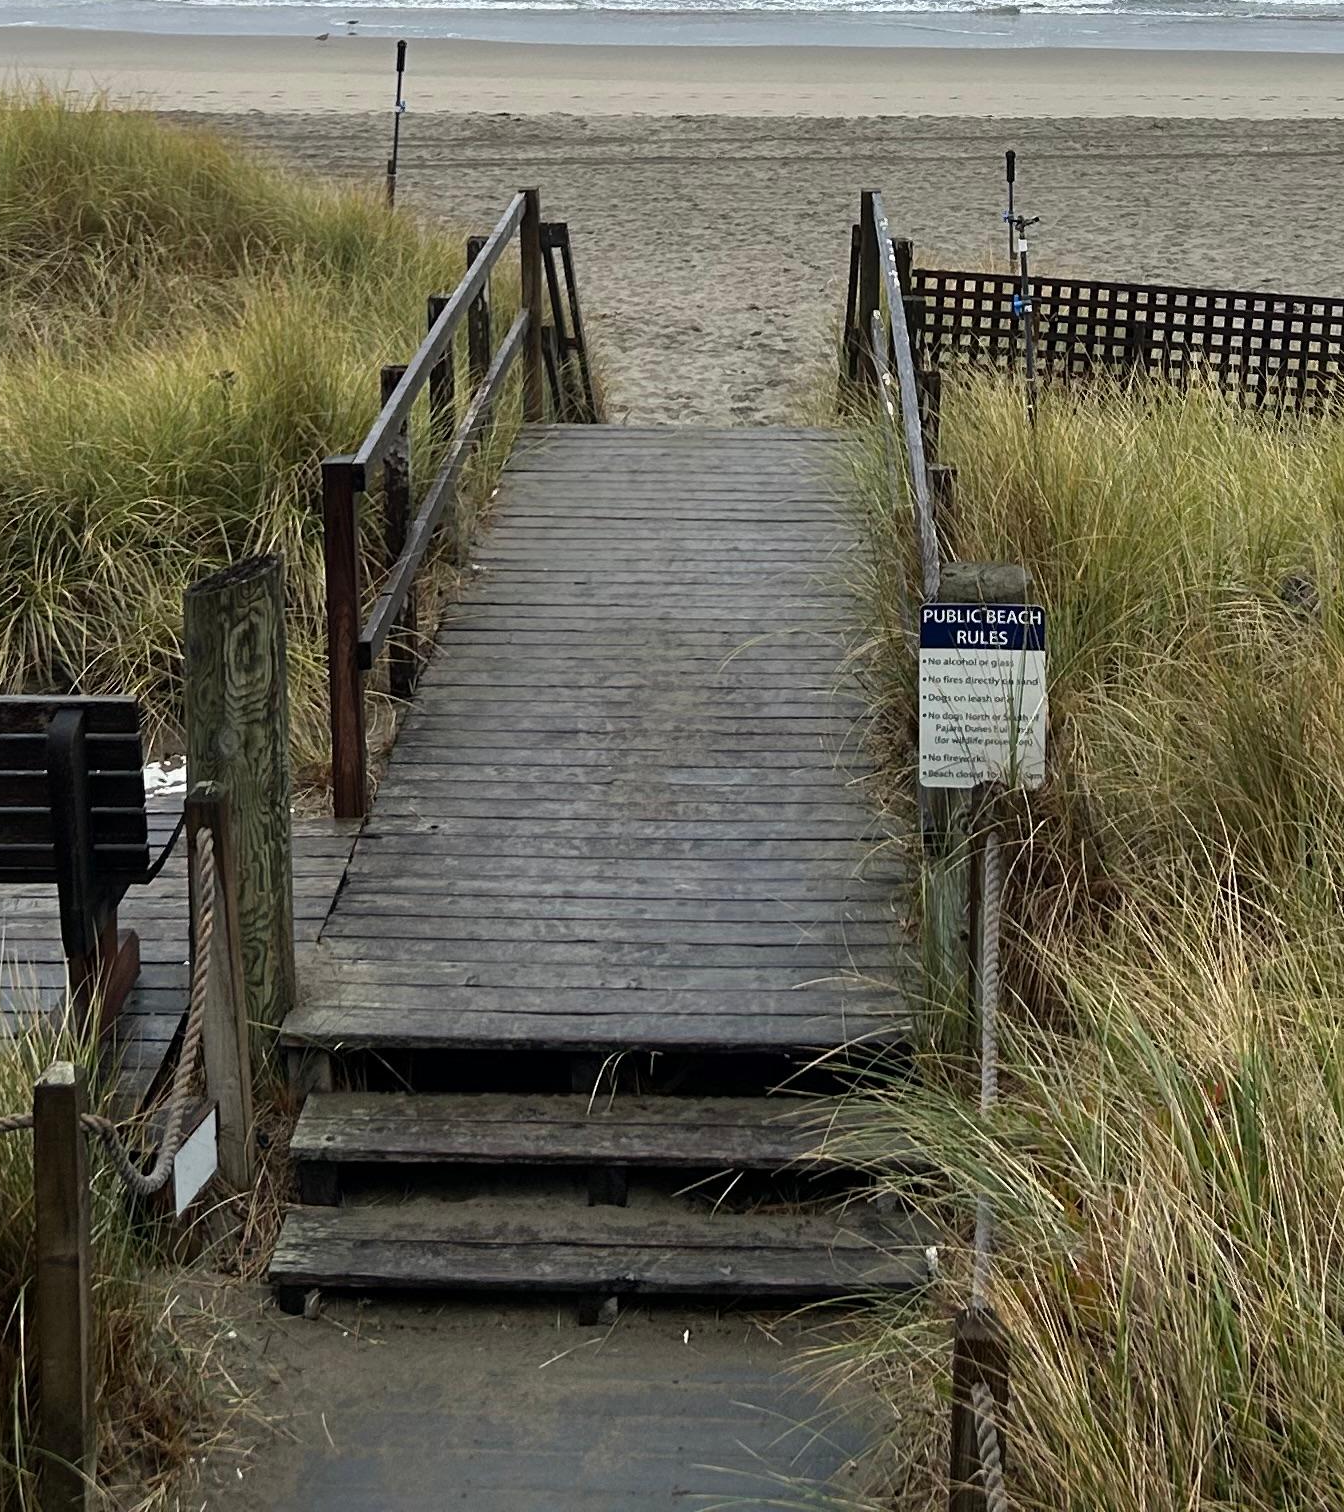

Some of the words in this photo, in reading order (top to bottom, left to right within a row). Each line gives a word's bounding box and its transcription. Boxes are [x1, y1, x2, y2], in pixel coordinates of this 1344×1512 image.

[923, 609, 981, 624] PUBLIC
[986, 610, 1042, 626] BEACH
[956, 630, 1008, 645] RULES
[928, 657, 941, 666] No
[943, 657, 977, 666] alcohol
[928, 675, 941, 684] No
[943, 675, 963, 684] fires
[965, 676, 1000, 686] directly
[928, 693, 951, 703] Dogs
[968, 693, 992, 702] leash
[928, 711, 940, 720] No
[942, 711, 963, 722] dogs
[965, 712, 990, 721] North
[965, 724, 992, 733] Dunes
[928, 753, 941, 762] No
